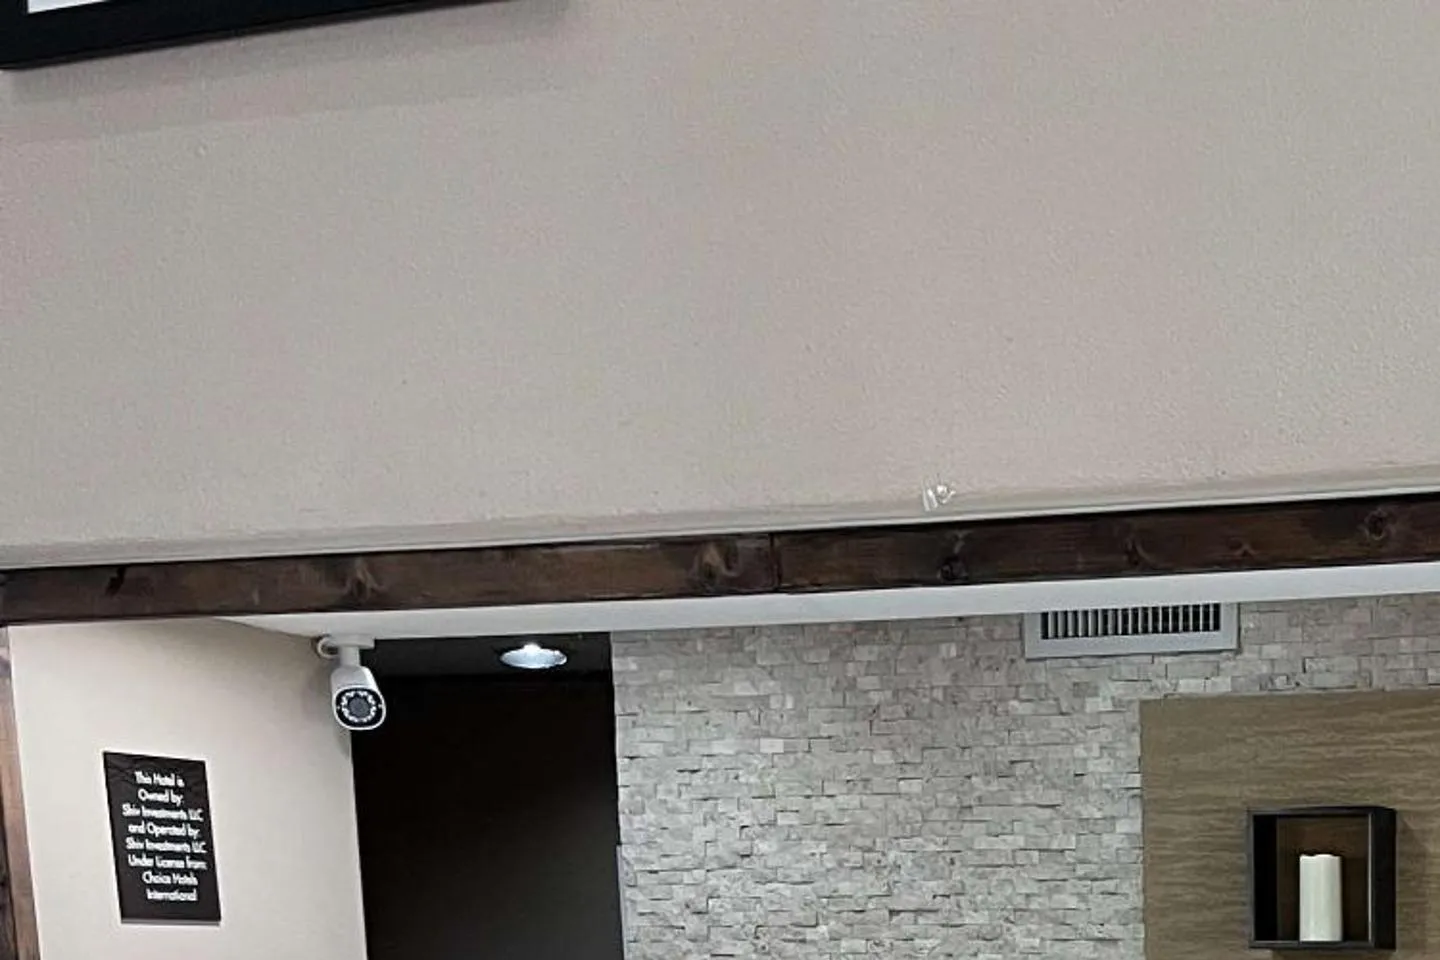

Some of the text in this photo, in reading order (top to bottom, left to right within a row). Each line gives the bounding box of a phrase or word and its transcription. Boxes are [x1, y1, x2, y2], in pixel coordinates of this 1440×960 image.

[135, 771, 185, 787] This Hotel is
[138, 788, 169, 803] Owned
[128, 820, 145, 834] and
[146, 821, 186, 838] Operated
[128, 852, 154, 867] Under
[142, 871, 199, 886] Choice Hotels
